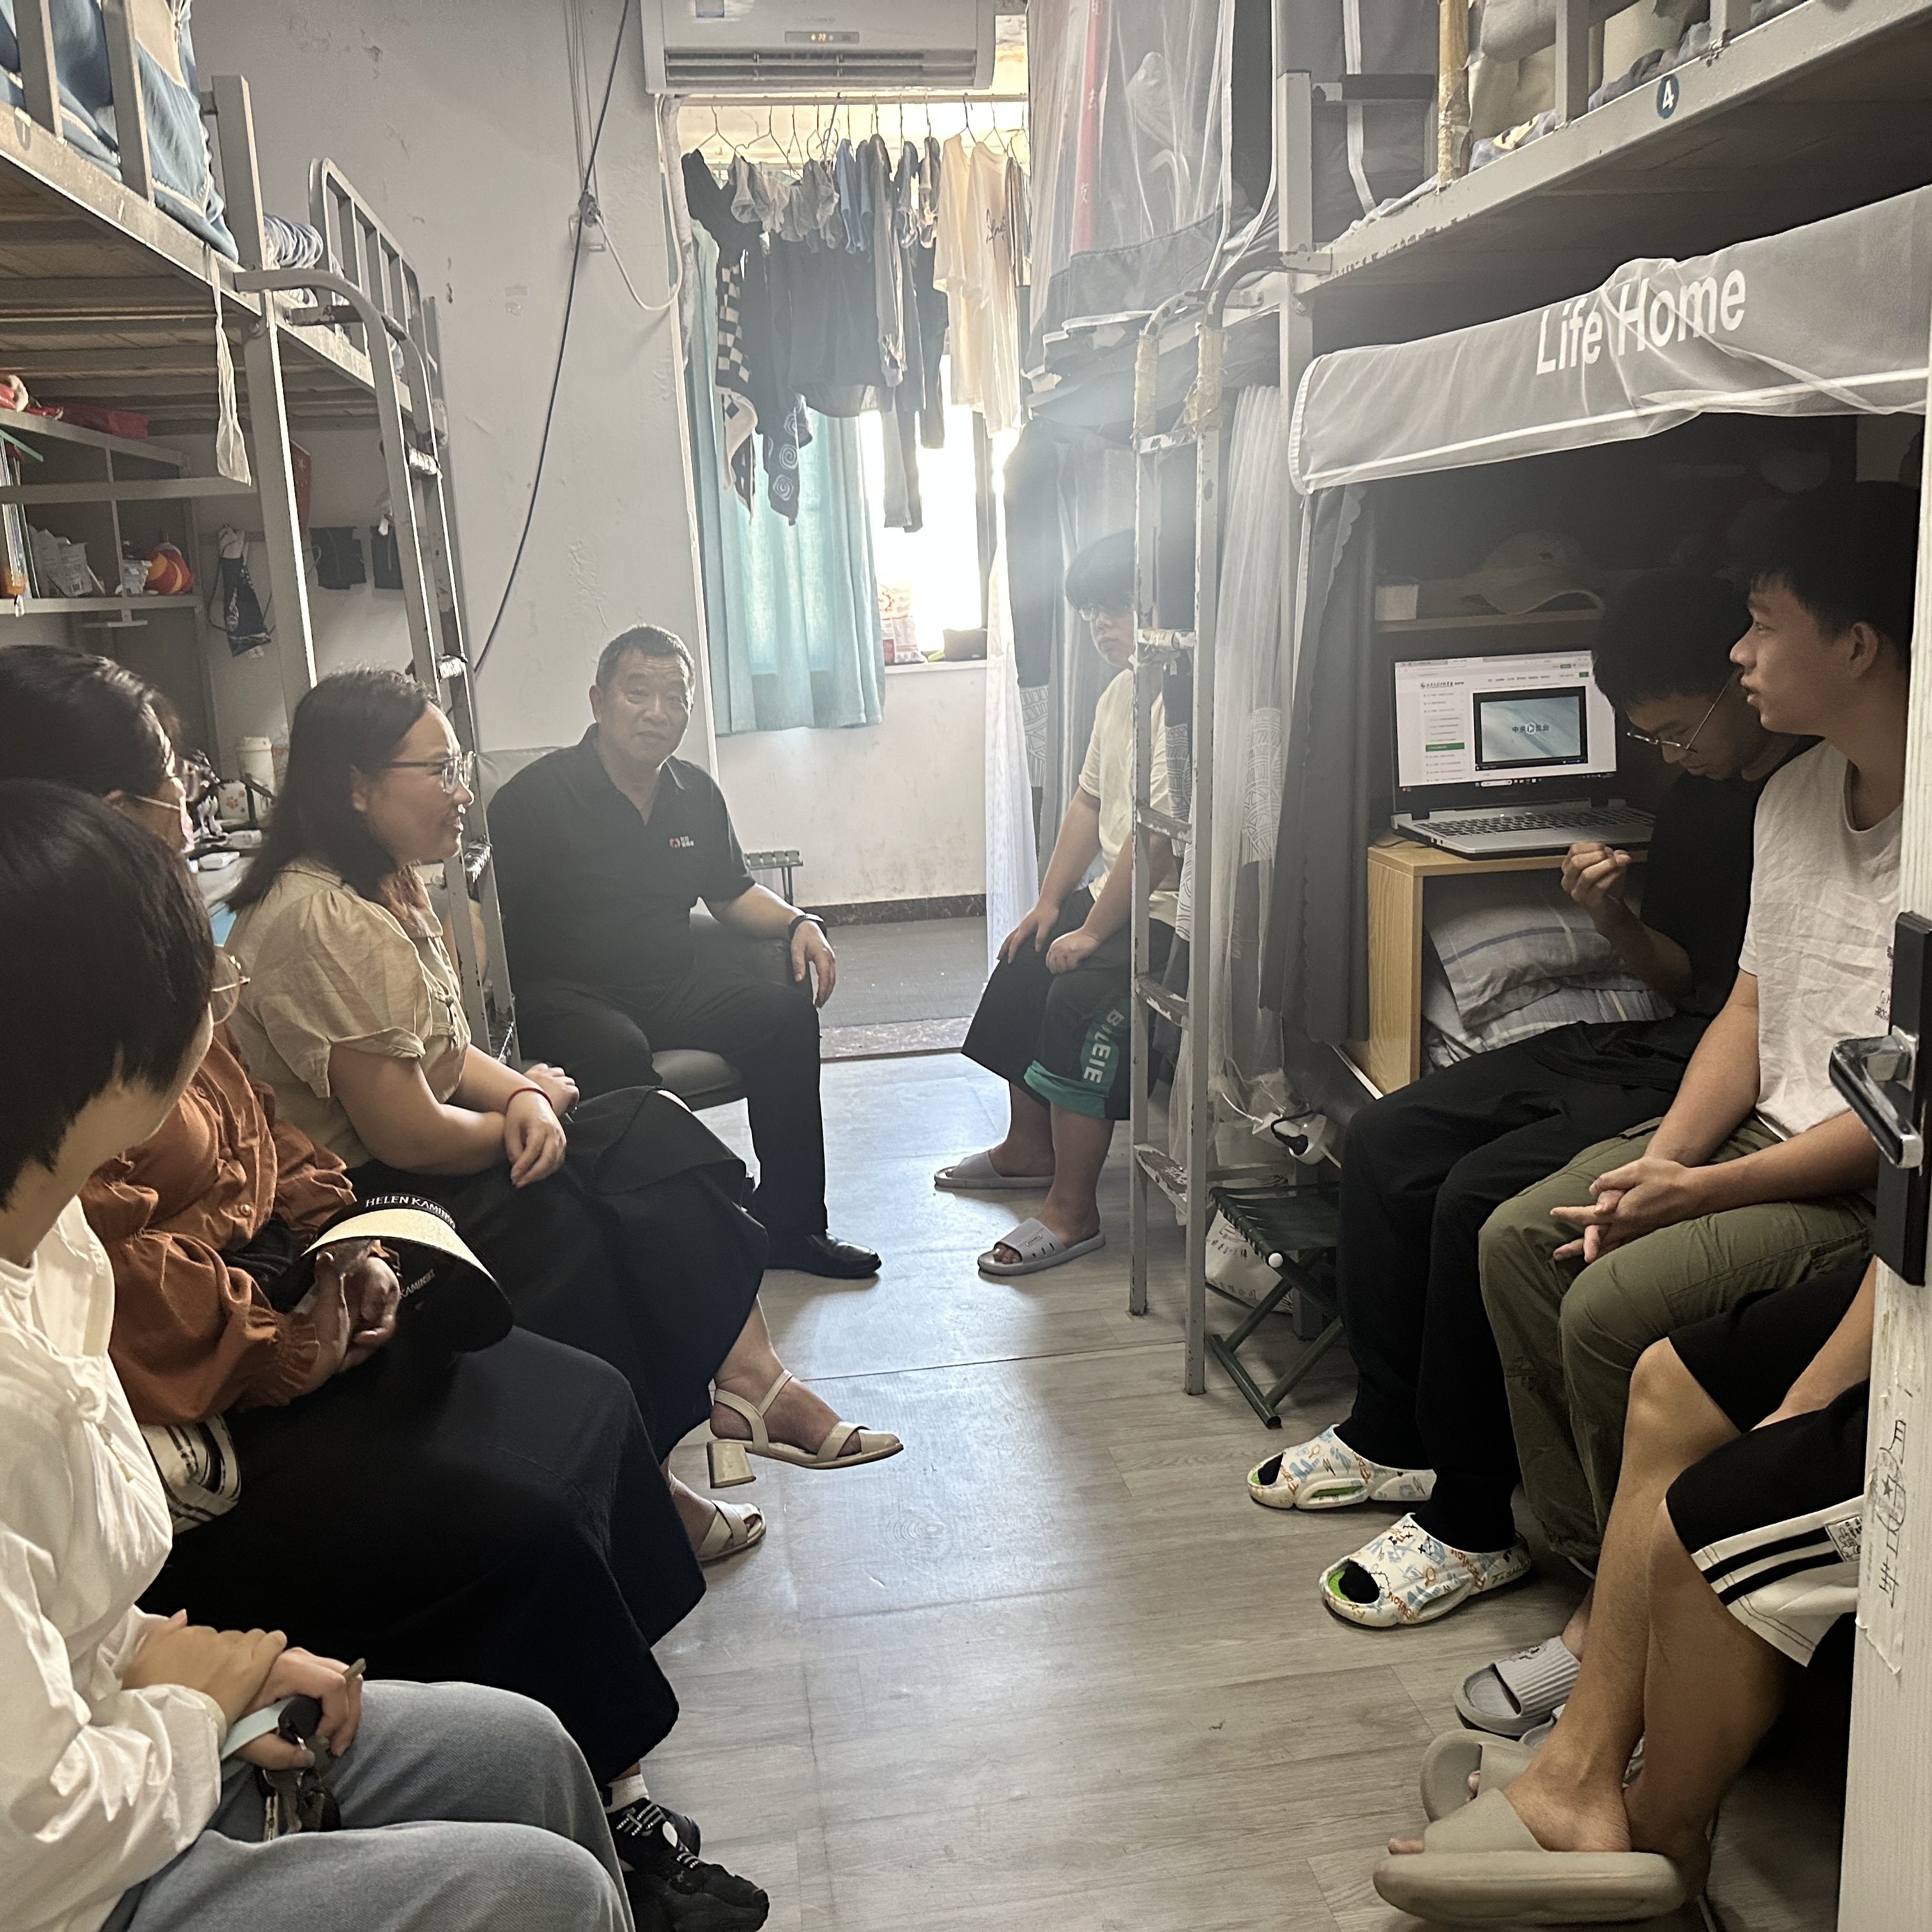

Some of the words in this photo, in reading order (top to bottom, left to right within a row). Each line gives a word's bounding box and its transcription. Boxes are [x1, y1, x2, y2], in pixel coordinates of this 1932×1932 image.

[1662, 79, 1675, 110] 4
[1537, 297, 1602, 375] Life
[1618, 269, 1746, 356] Home
[365, 1195, 409, 1208] HELEN
